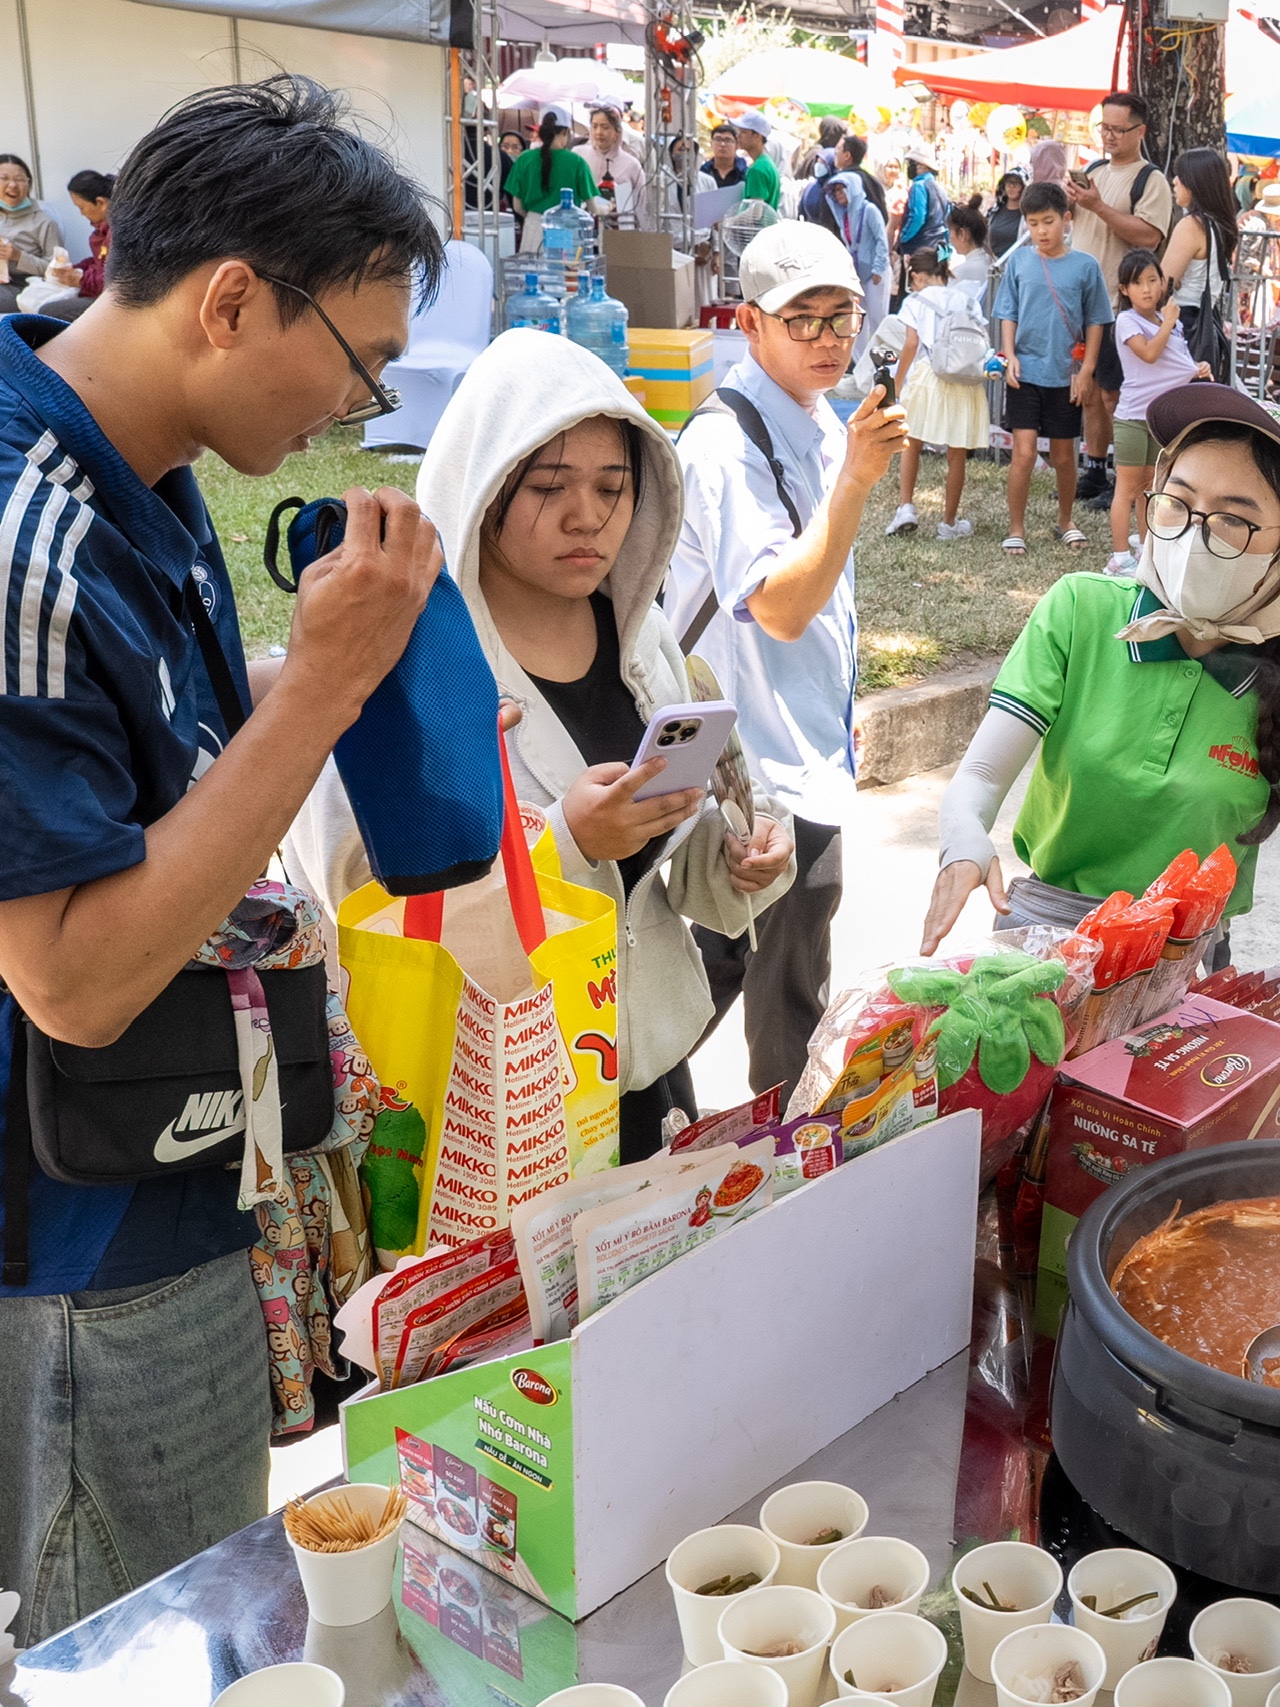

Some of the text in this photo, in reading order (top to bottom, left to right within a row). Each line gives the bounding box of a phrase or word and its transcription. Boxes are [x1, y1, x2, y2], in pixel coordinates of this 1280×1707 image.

[504, 982, 552, 1020] MIKKO
[504, 1016, 528, 1029] Hotline:
[505, 1011, 554, 1048] MIKKO
[505, 1038, 557, 1075] MIKKO
[1164, 1051, 1177, 1063] SA
[1176, 1035, 1210, 1056] NƯỚNG
[505, 1071, 531, 1084] Hotline:
[506, 1066, 559, 1102] MIKKO
[1213, 1057, 1246, 1085] Barona
[176, 1091, 246, 1132] NIK
[505, 1098, 532, 1111] Hotline:
[535, 1089, 549, 1102] 1900
[506, 1093, 561, 1129] MIKKO
[506, 1126, 532, 1137] Hotline:
[535, 1117, 551, 1129] 1900
[1071, 1098, 1161, 1137] Xốt Gia Vị Hoàn Chỉnh
[467, 1141, 482, 1153] 1900
[506, 1119, 564, 1155] MIKKO
[1074, 1115, 1157, 1155] NƯỚNG SA TẾ
[441, 1146, 496, 1177] MIKKO
[506, 1152, 533, 1163] Hotline:
[536, 1143, 551, 1155] 1900
[507, 1146, 567, 1181] MIKKO
[437, 1173, 498, 1203] MIKKO
[462, 1170, 477, 1181] 1900
[507, 1178, 532, 1189] Hotline:
[535, 1169, 552, 1181] 1900
[507, 1172, 569, 1206] MIKKO
[435, 1189, 497, 1212] Hotline: 1900 3089
[432, 1201, 496, 1229] MIKKO
[429, 1229, 471, 1248] MIK
[456, 1226, 474, 1235] 1900
[595, 1240, 611, 1253] XỐT
[631, 1226, 642, 1239] BÒ
[662, 1207, 693, 1226] BARONA
[657, 1224, 676, 1237] SAUCE
[514, 1371, 552, 1396] Barona
[473, 1395, 552, 1451] Nấu Cơm Nhà
[478, 1417, 549, 1469] Nhớ Barona
[523, 1466, 543, 1484] NGON
